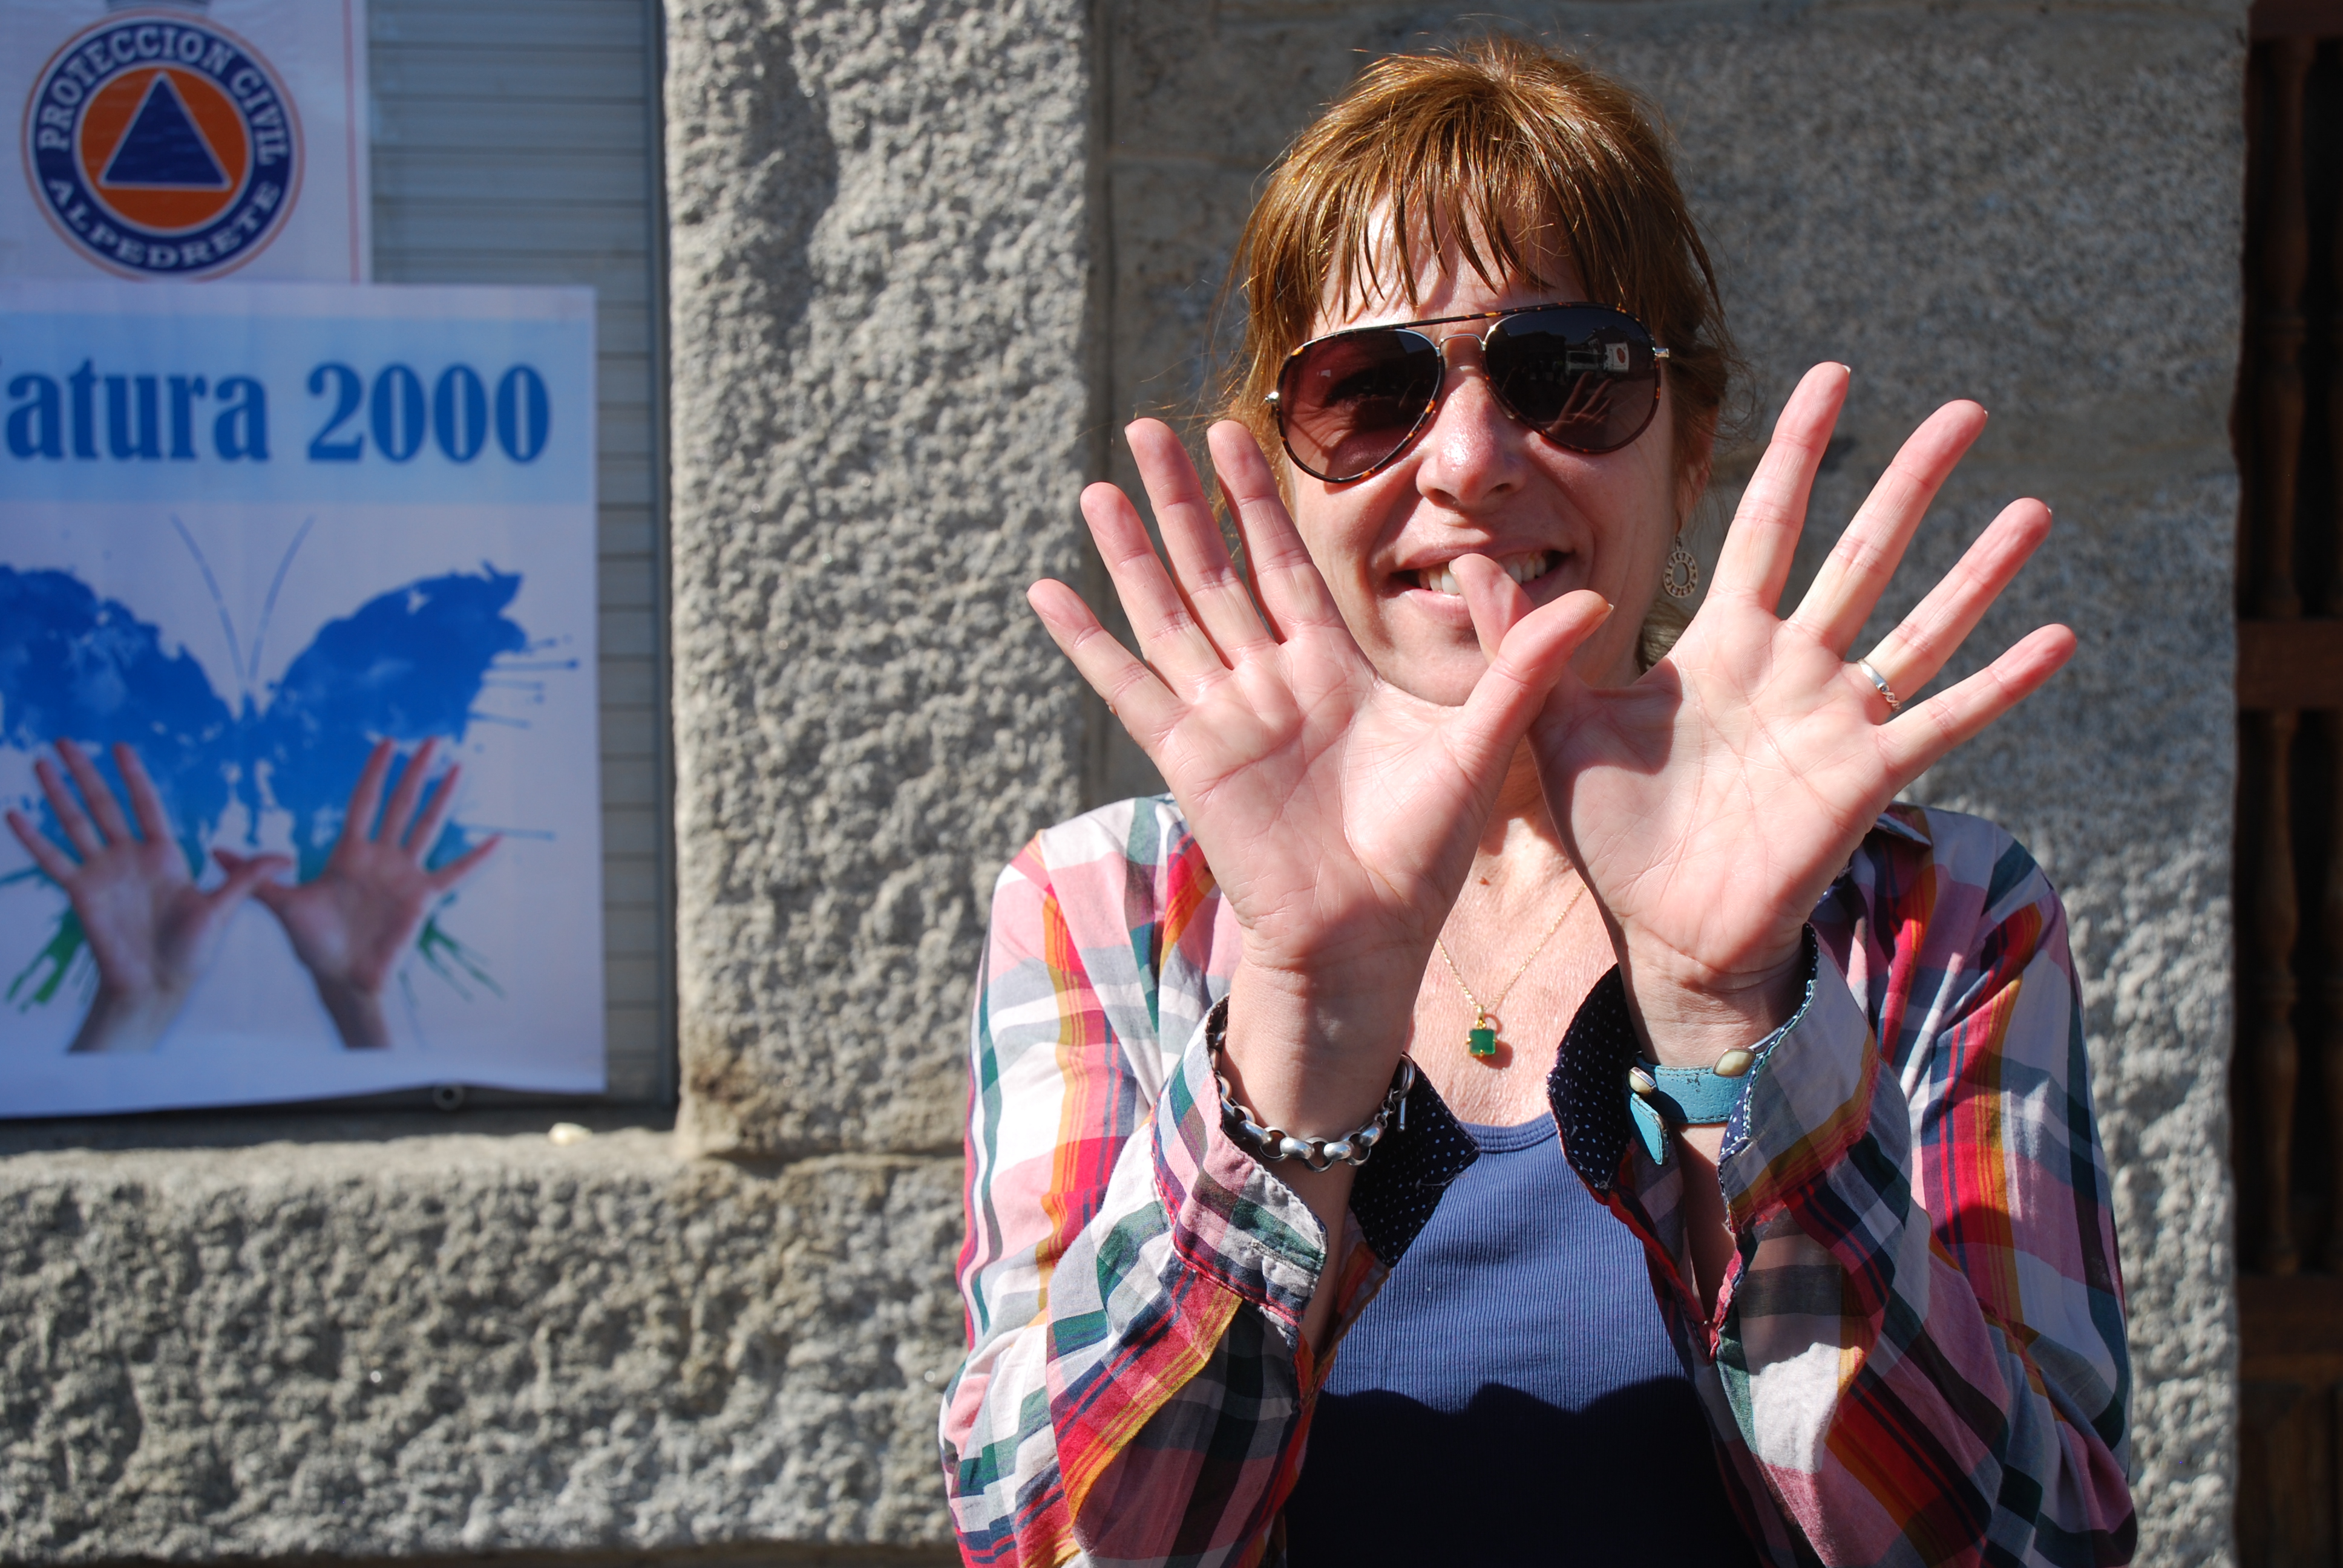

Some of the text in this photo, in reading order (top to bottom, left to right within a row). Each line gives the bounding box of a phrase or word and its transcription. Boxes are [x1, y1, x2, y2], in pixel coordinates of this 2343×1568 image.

[38, 26, 287, 166] PROTECCION CIVIL
[48, 178, 280, 267] ALPEDRETE
[0, 358, 551, 463] atura 2000
